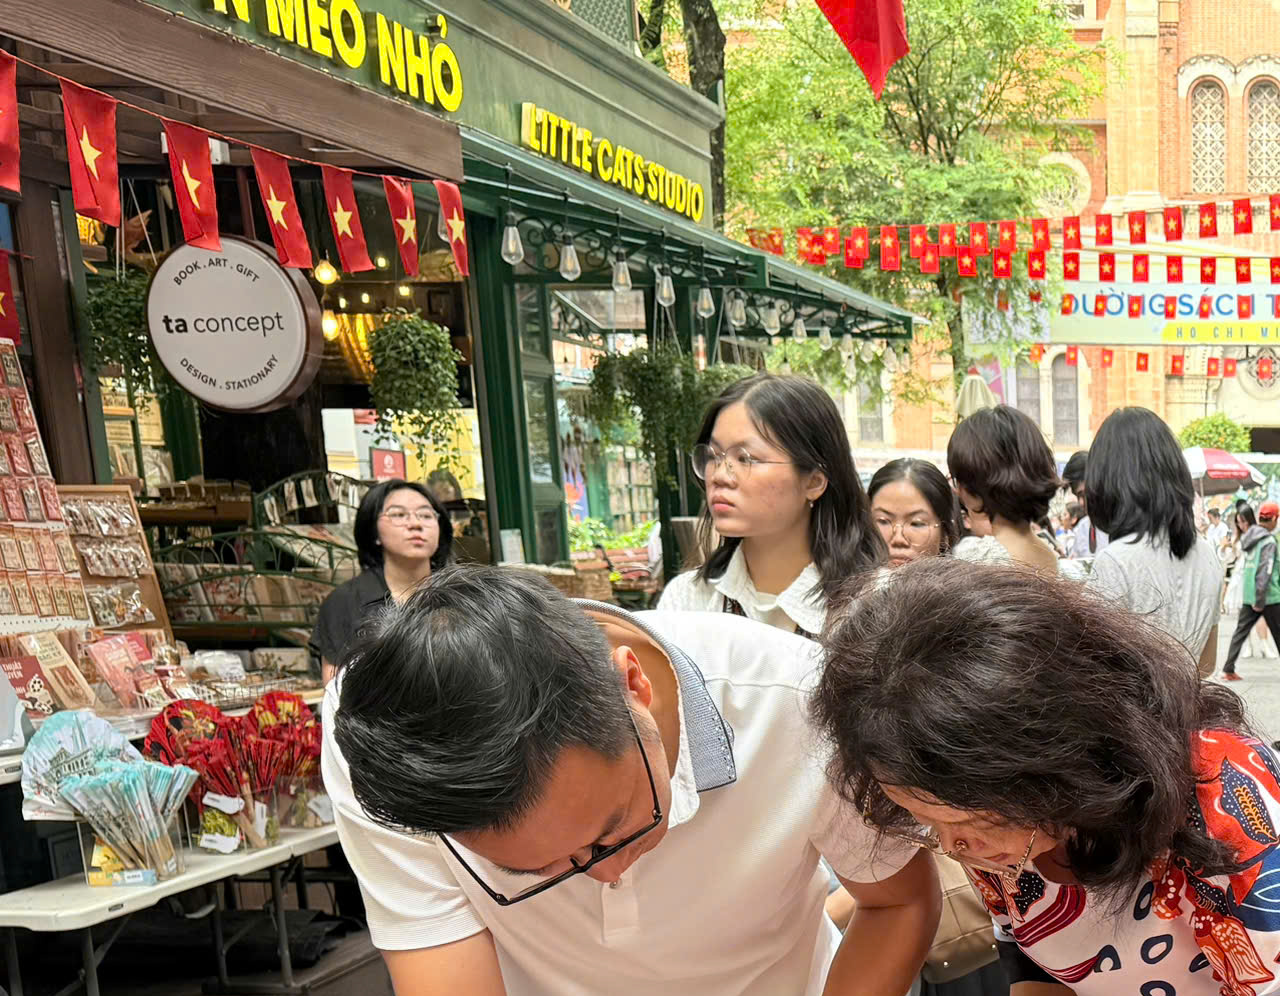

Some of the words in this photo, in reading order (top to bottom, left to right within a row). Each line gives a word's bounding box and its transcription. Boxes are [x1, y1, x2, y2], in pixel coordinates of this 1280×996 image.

[376, 13, 463, 112] NHỎ
[521, 102, 593, 174] LITTLE
[597, 137, 645, 195] CATS
[647, 161, 705, 224] STUDIO
[173, 260, 202, 286] BOOK
[208, 257, 229, 268] ART
[236, 263, 260, 283] GIFT
[162, 315, 189, 334] ta
[193, 312, 285, 337] concept
[1176, 326, 1196, 338] HO
[1213, 326, 1244, 338] CHI
[180, 358, 217, 388] DESIGN
[225, 354, 279, 391] STATIONARY
